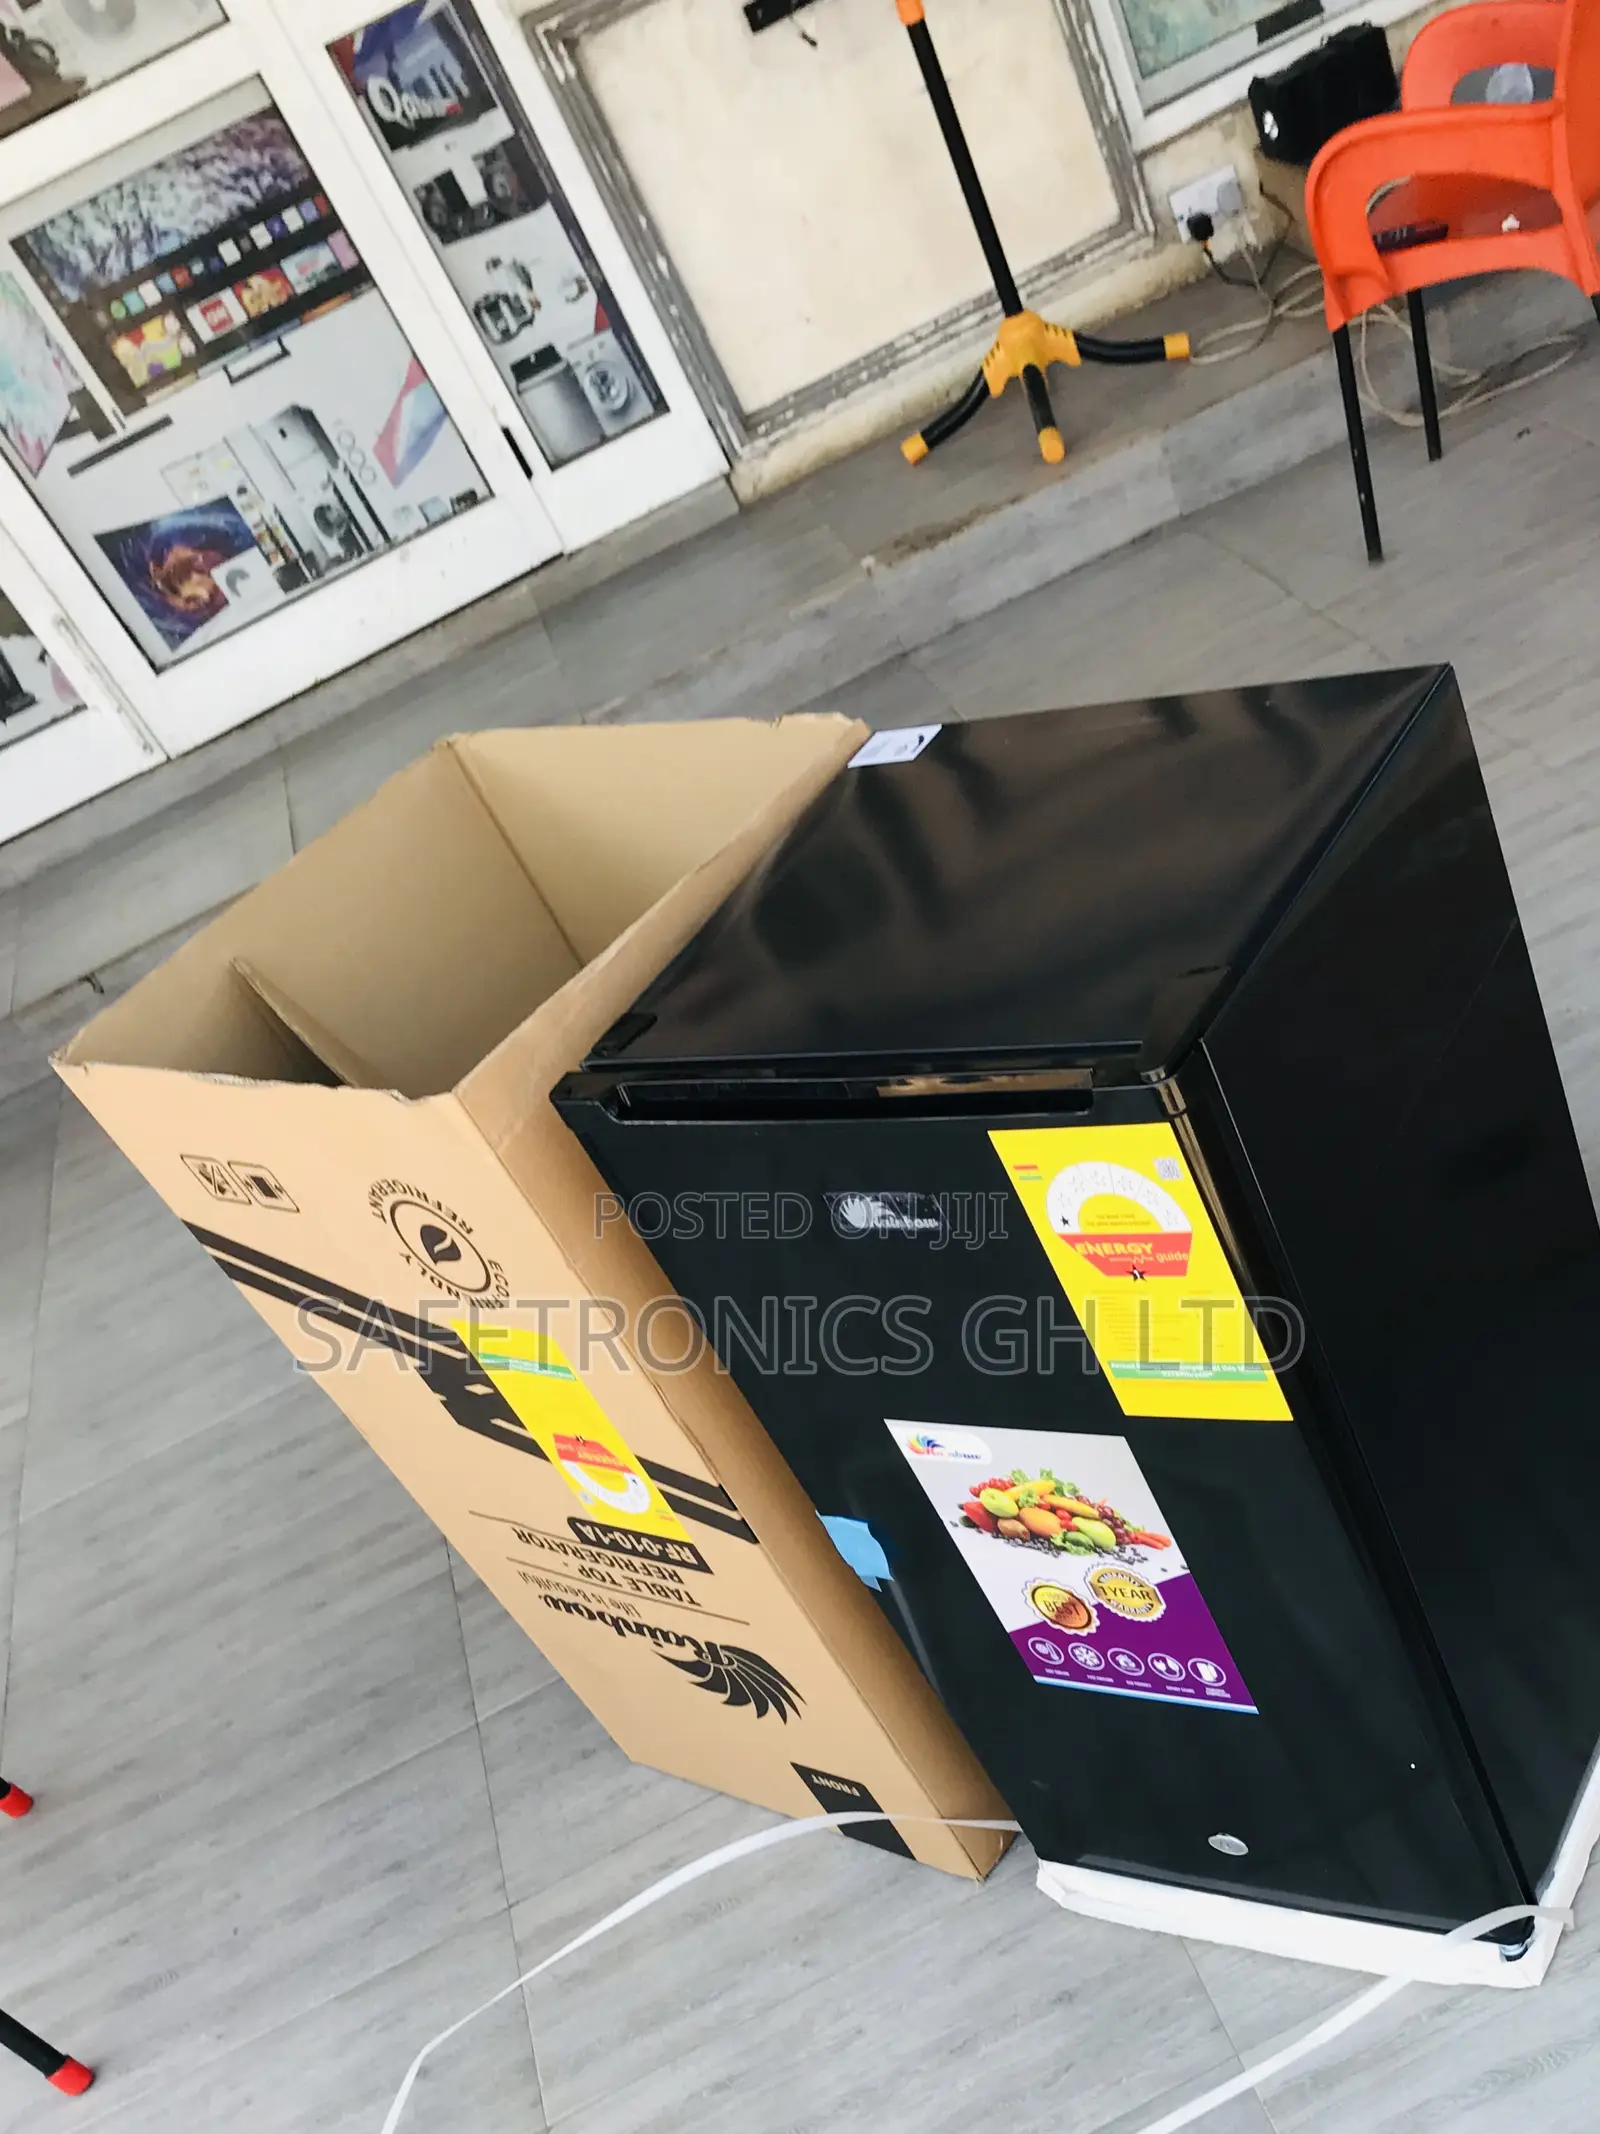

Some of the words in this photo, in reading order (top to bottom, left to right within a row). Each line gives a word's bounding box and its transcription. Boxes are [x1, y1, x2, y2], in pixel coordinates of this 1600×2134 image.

[1074, 1241, 1154, 1258] ENERGY
[1156, 1251, 1189, 1264] guide
[574, 1521, 699, 1566] RF-010-1A
[511, 1527, 684, 1585] REFRIGERATOR
[578, 1564, 623, 1588] TOP
[624, 1575, 702, 1607] TABLE
[1108, 1587, 1153, 1601] YEAR
[614, 1600, 642, 1619] Life
[811, 1774, 861, 1797] FRONT
